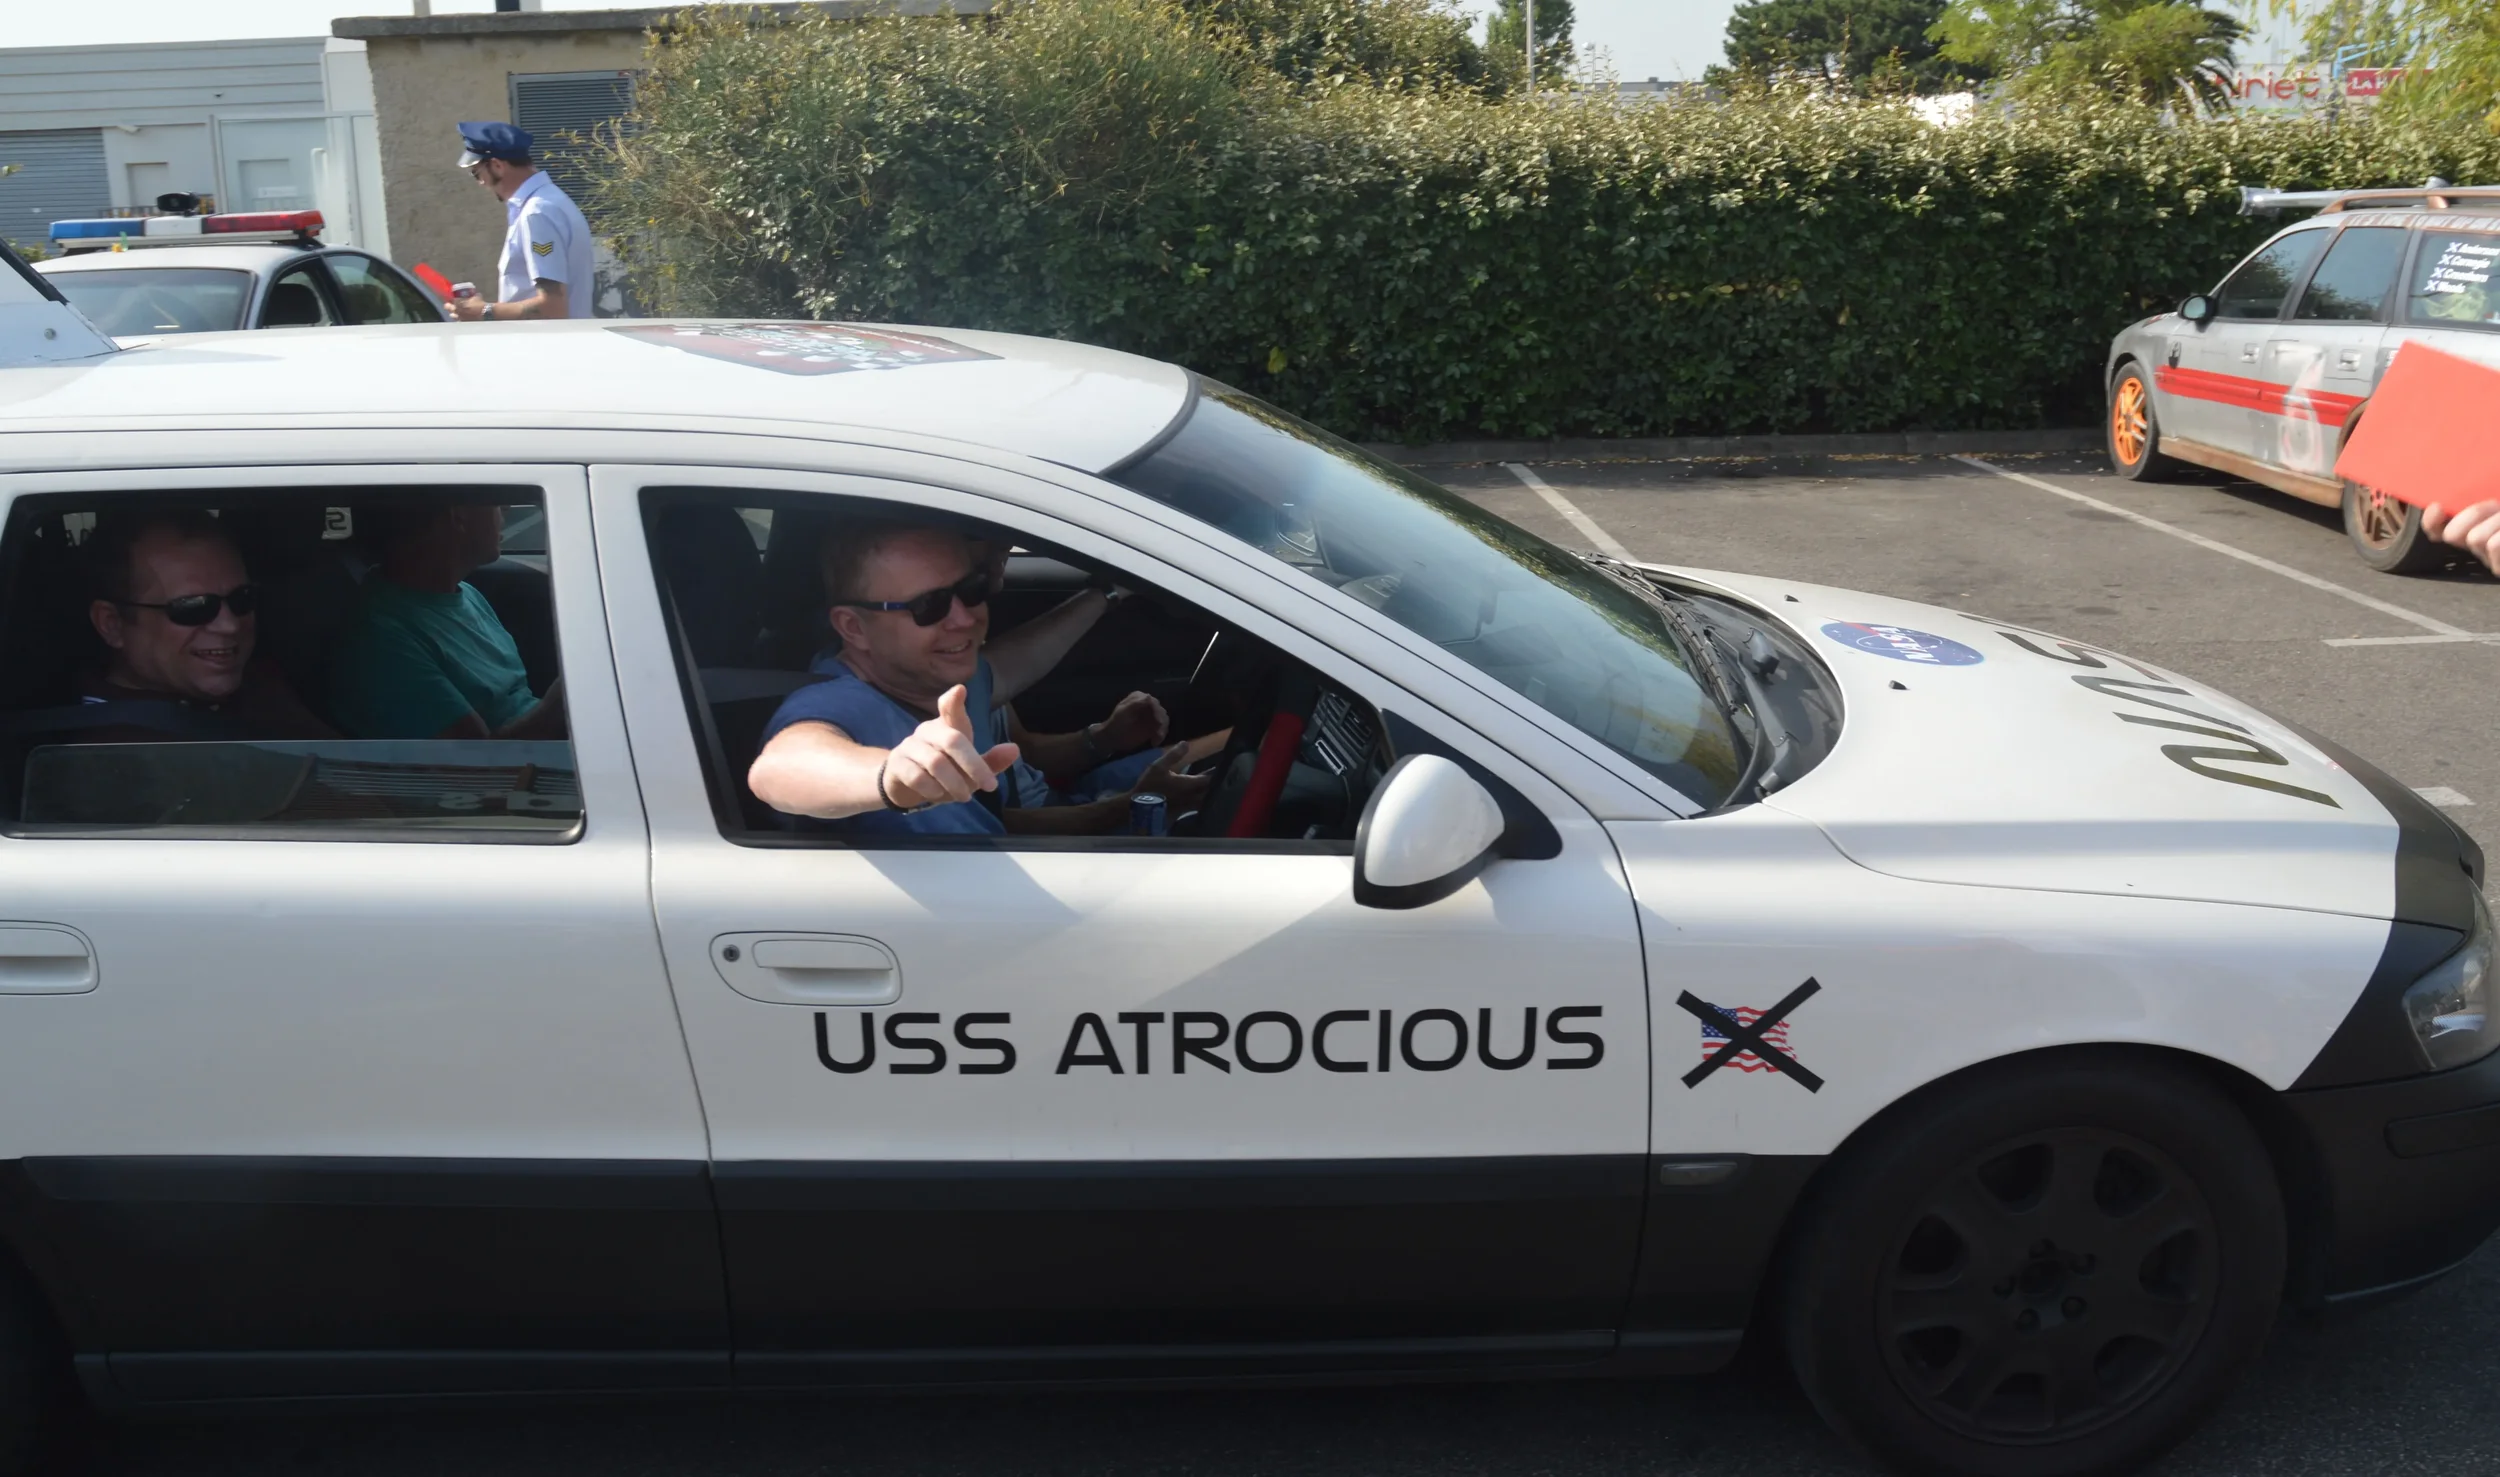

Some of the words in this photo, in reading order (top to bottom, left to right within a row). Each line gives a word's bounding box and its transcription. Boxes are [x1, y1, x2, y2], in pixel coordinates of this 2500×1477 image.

[1869, 626, 1941, 663] NASA
[813, 1011, 1017, 1075] USS
[1056, 1006, 1604, 1075] ATROCIOUS
